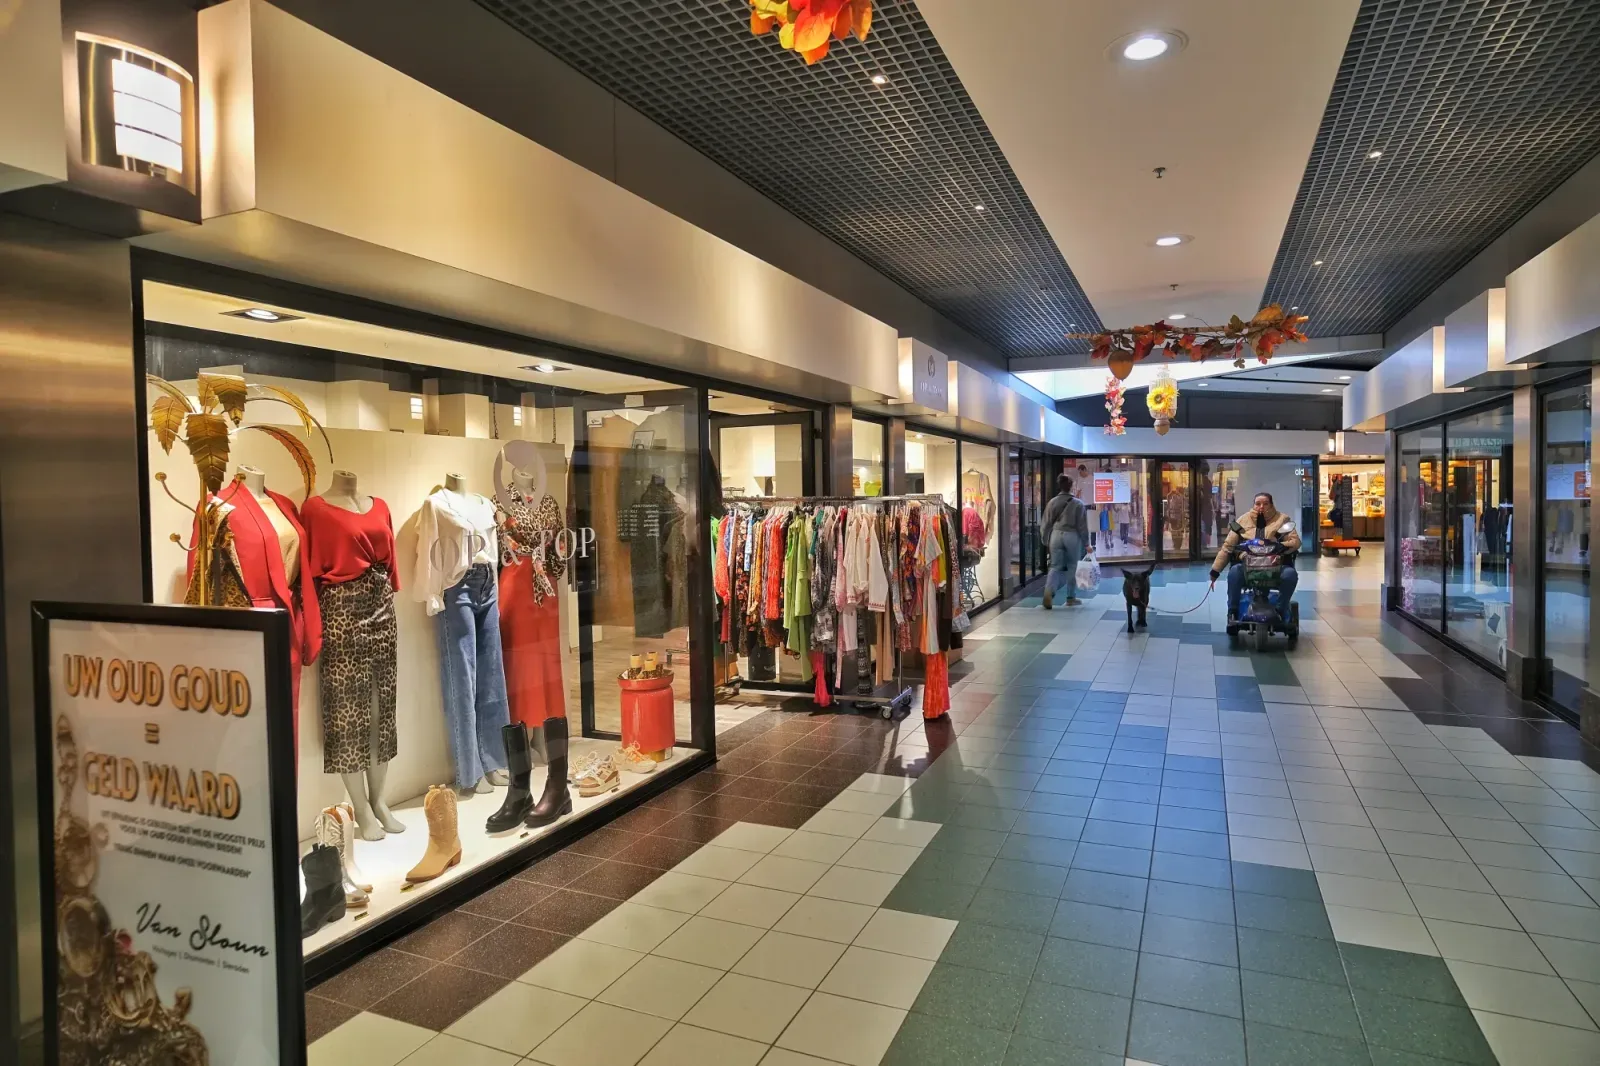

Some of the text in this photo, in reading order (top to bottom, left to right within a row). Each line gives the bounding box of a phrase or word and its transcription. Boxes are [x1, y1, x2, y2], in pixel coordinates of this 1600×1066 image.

[429, 527, 596, 573] OP & TOP
[63, 653, 252, 718] UW OUD GOUD
[83, 751, 241, 821] GELD WAARD
[213, 831, 246, 845] HOOGSTE
[247, 837, 266, 849] PRIJS
[136, 902, 270, 957] Van Sloun
